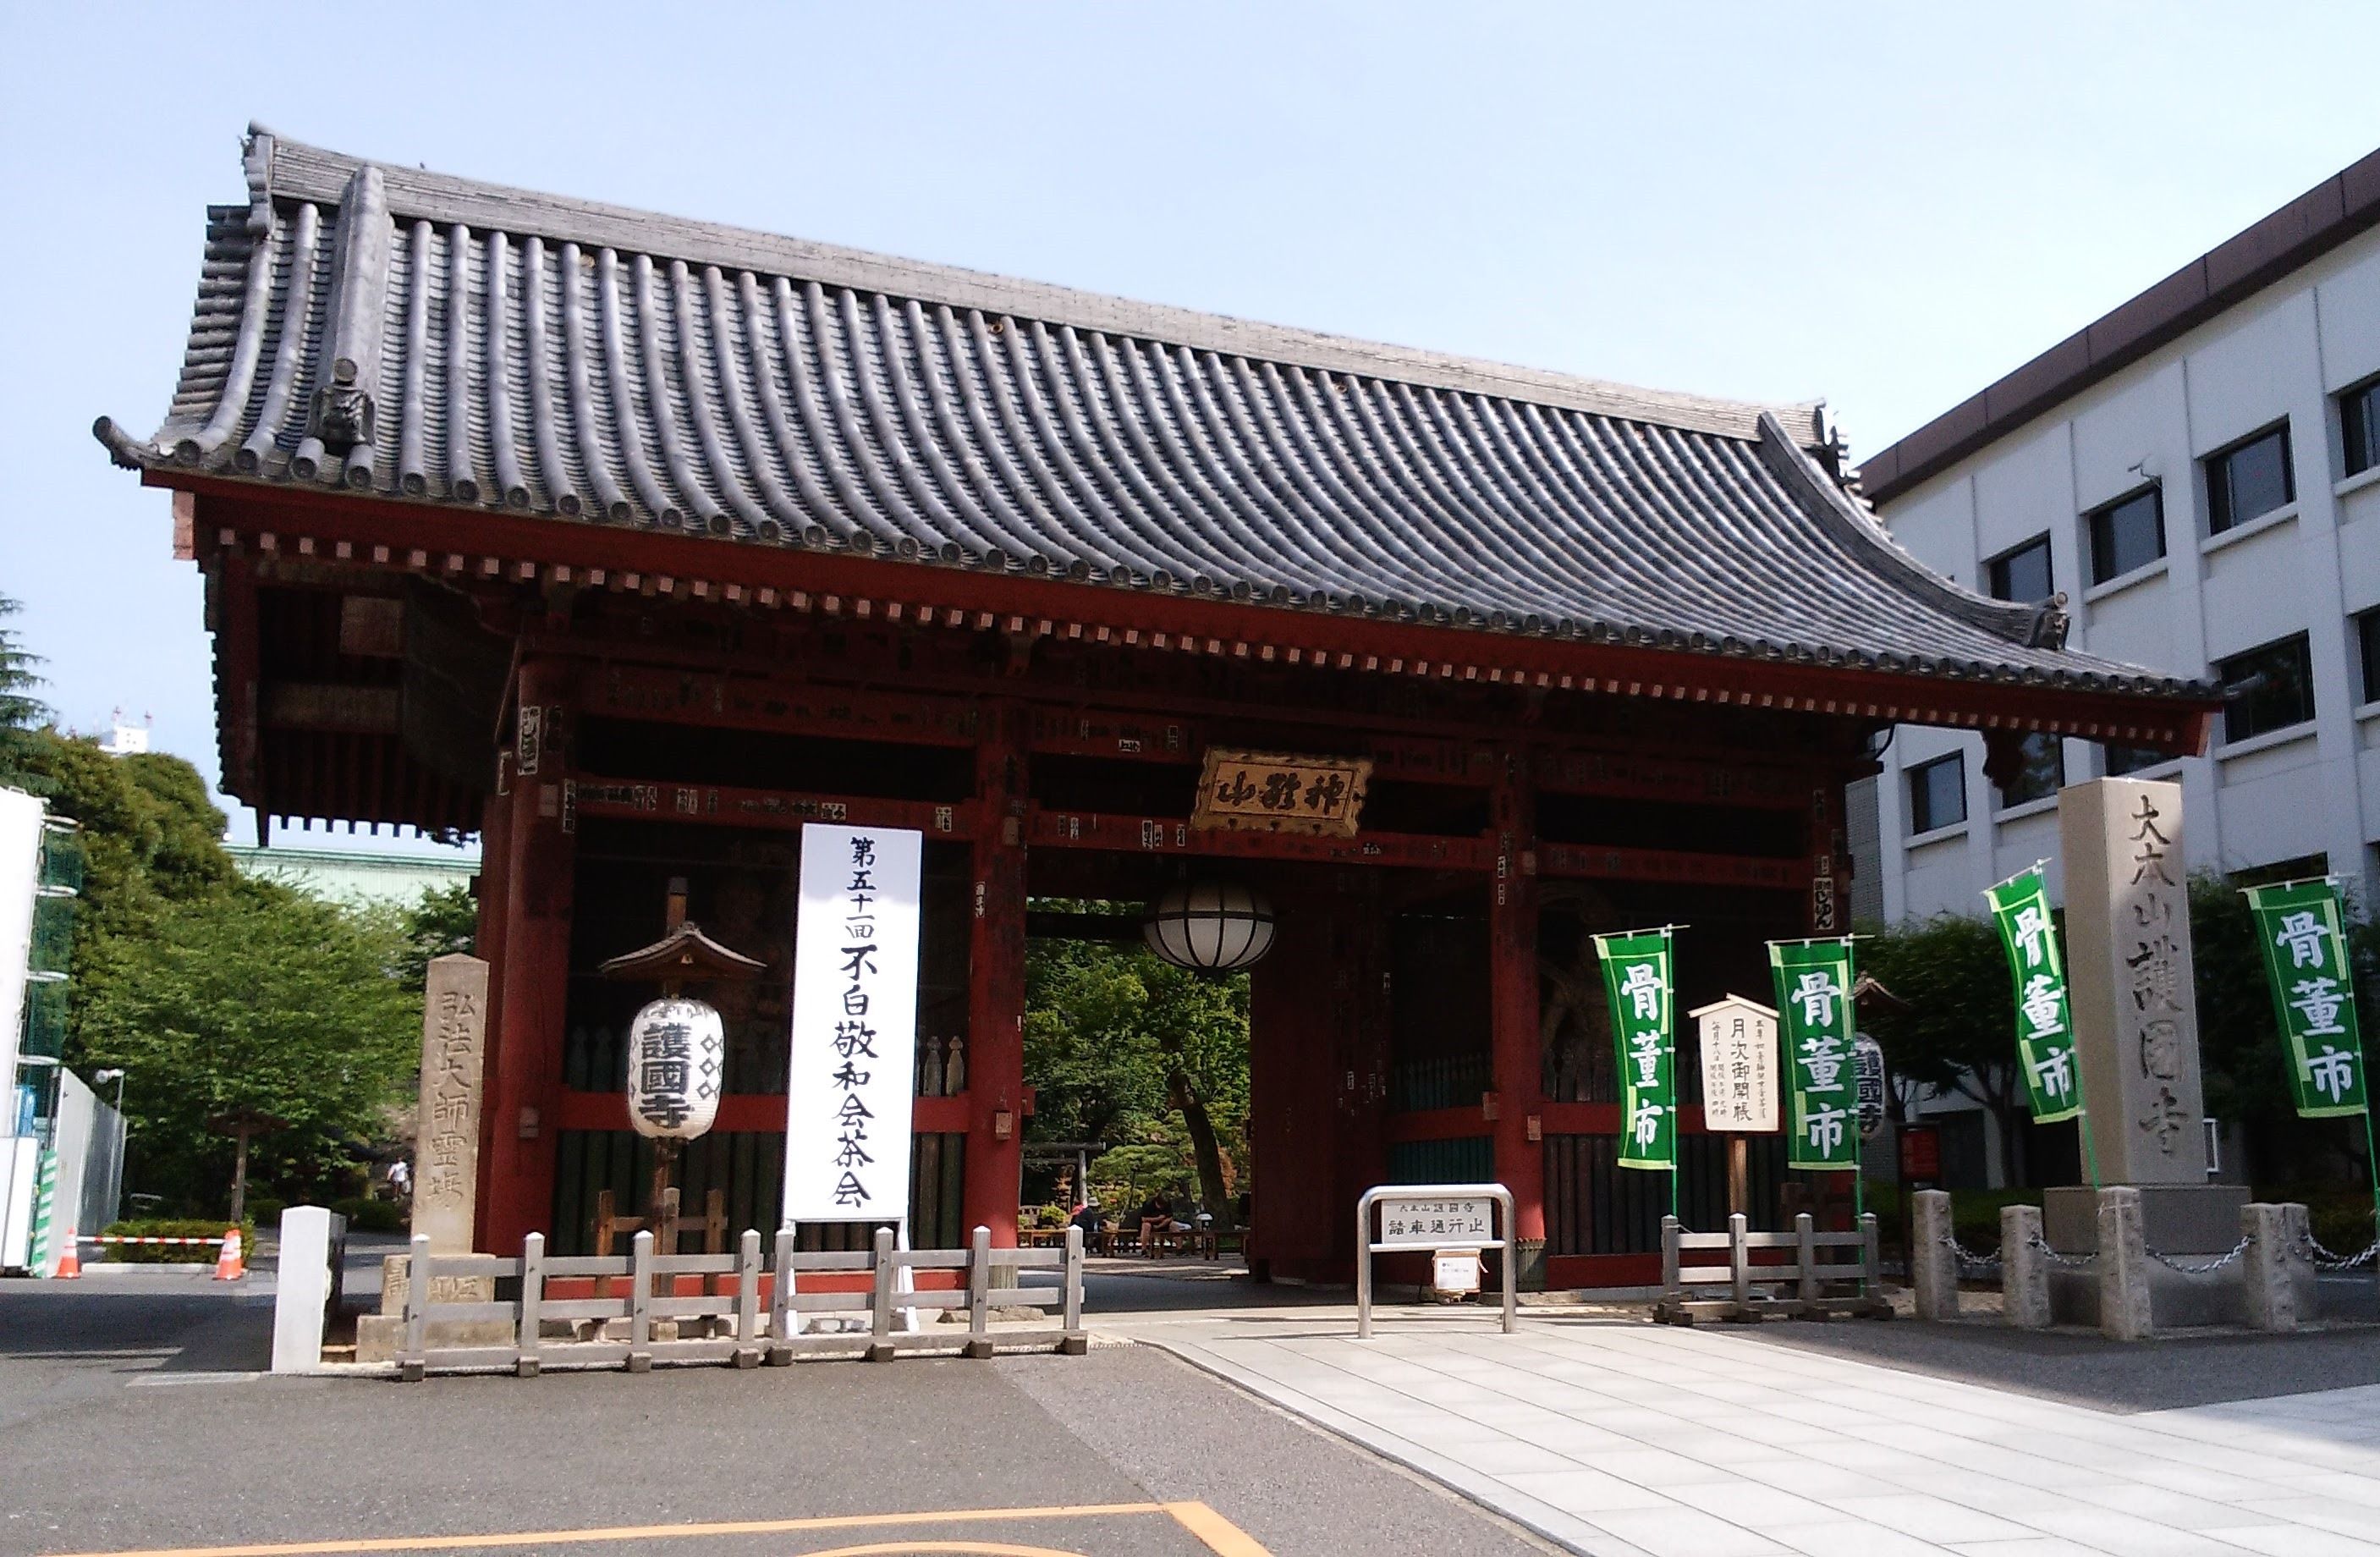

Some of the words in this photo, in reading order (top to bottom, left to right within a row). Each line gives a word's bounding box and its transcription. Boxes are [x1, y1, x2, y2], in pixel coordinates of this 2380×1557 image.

[1621, 963, 1664, 1157] 骨董市
[1731, 1018, 1753, 1122] 月次御開帳
[1791, 971, 1846, 1160] 骨董市
[2015, 906, 2070, 1107] 骨董市
[2276, 911, 2353, 1103] 骨董市
[1388, 1218, 1485, 1235] 諸車通行止
